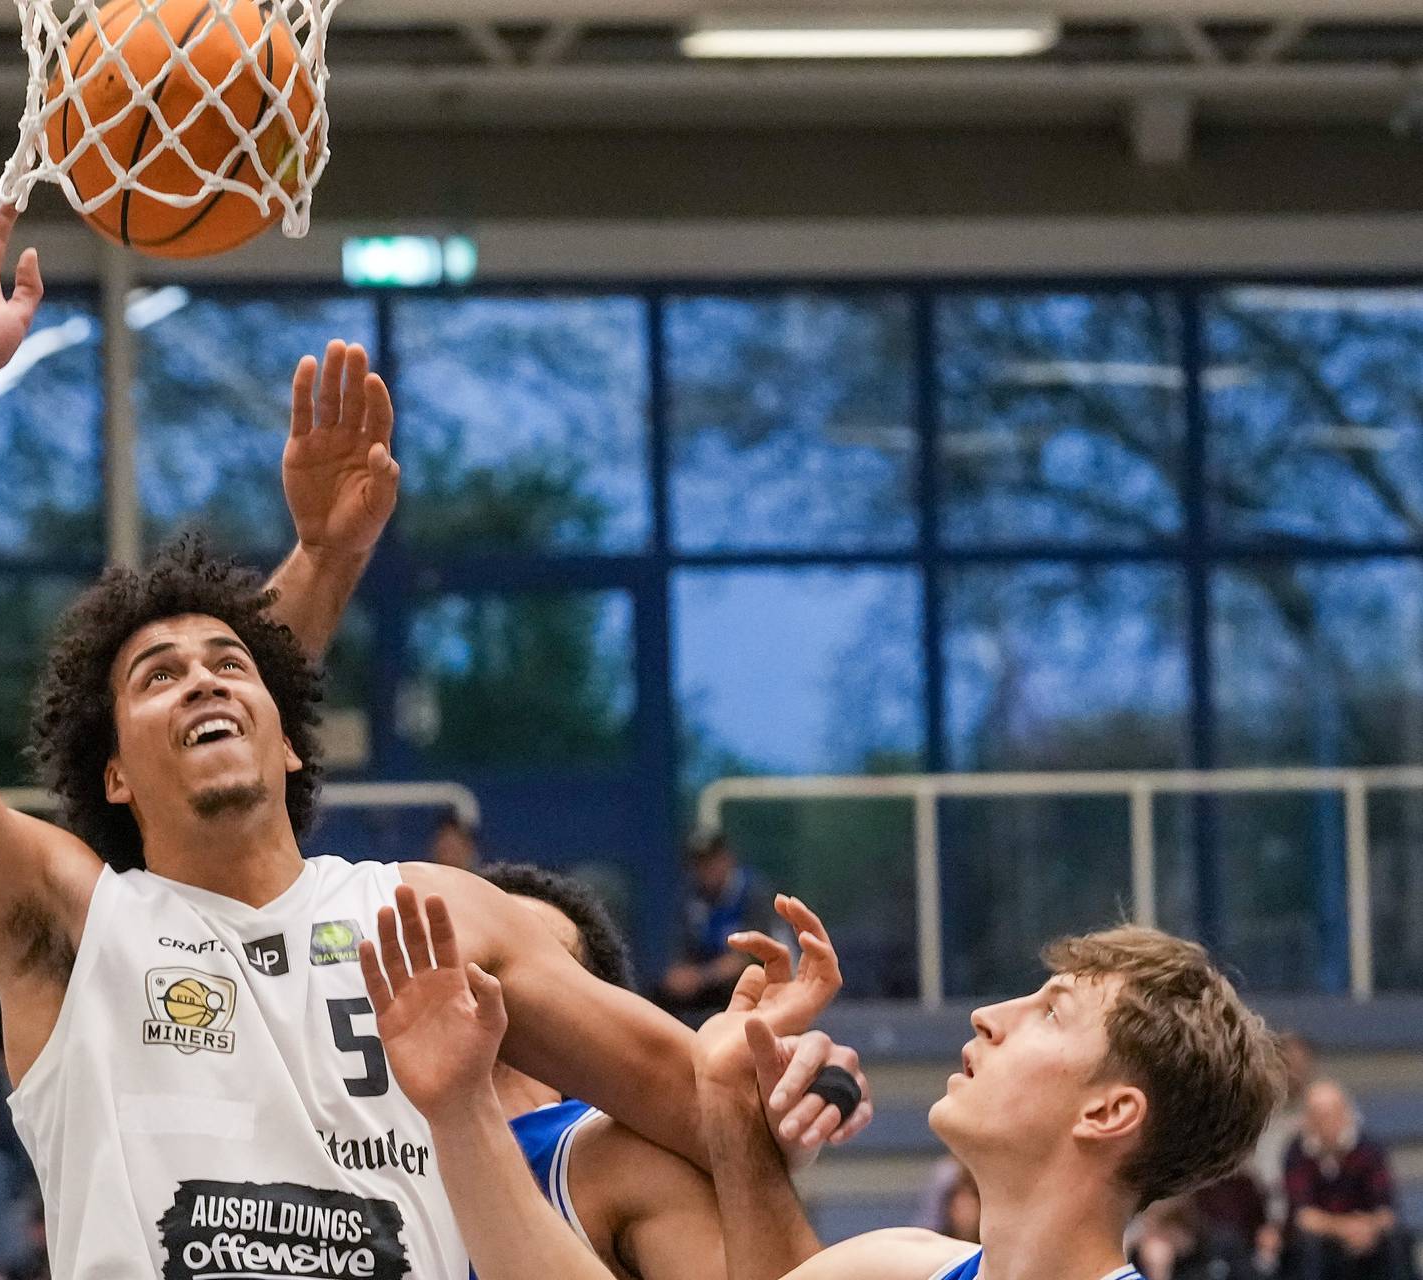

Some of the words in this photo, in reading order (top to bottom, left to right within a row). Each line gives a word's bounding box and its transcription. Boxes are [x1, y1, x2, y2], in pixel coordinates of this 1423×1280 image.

[314, 951, 360, 962] BARME
[148, 1024, 229, 1049] MINERS
[326, 997, 389, 1097] 5
[316, 1128, 429, 1178] tauer
[190, 1195, 372, 1243] AUSBILDUNGS-
[183, 1232, 375, 1277] offensive
